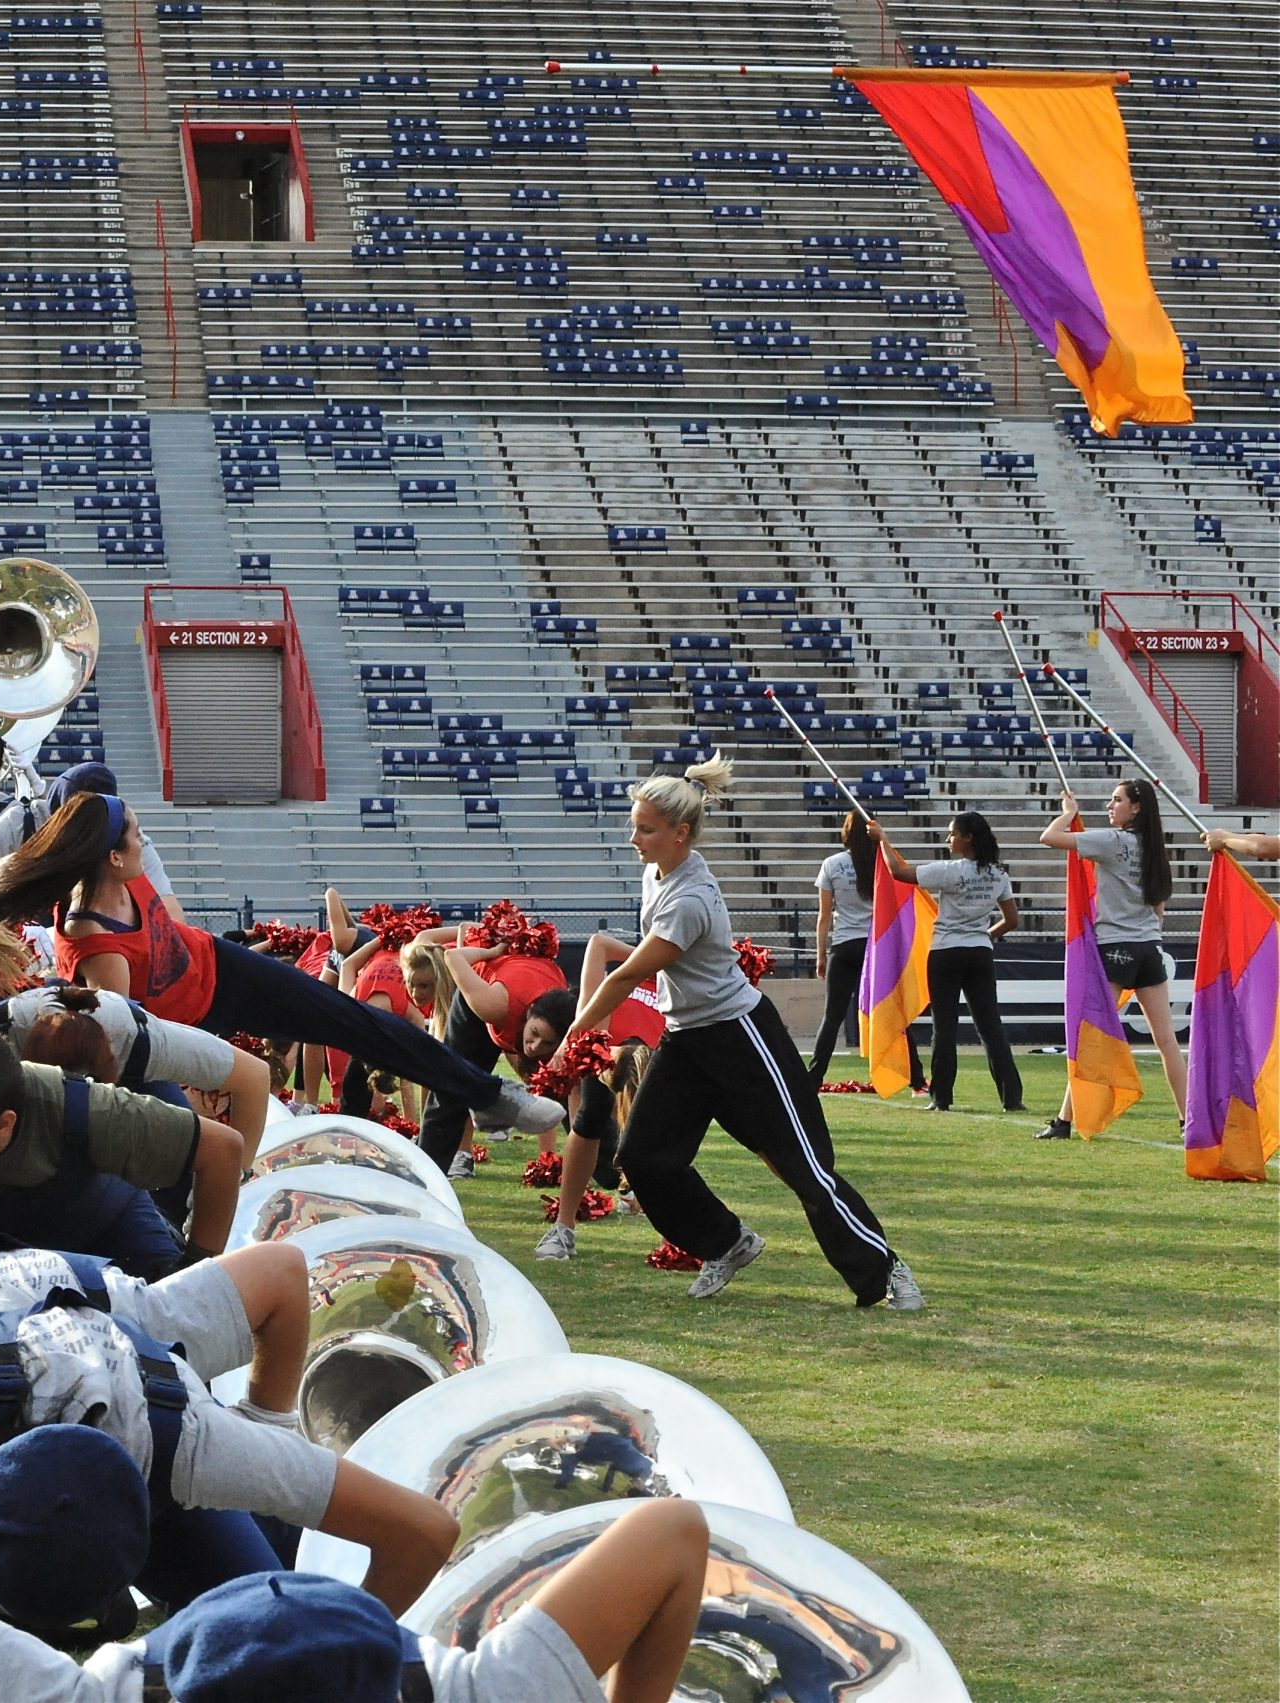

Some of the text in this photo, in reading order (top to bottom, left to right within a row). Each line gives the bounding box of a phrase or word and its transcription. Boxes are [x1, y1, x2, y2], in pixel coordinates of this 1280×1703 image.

[181, 632, 256, 644] 21 SECTION 22
[1146, 637, 1218, 649] 22 SECTION 23
